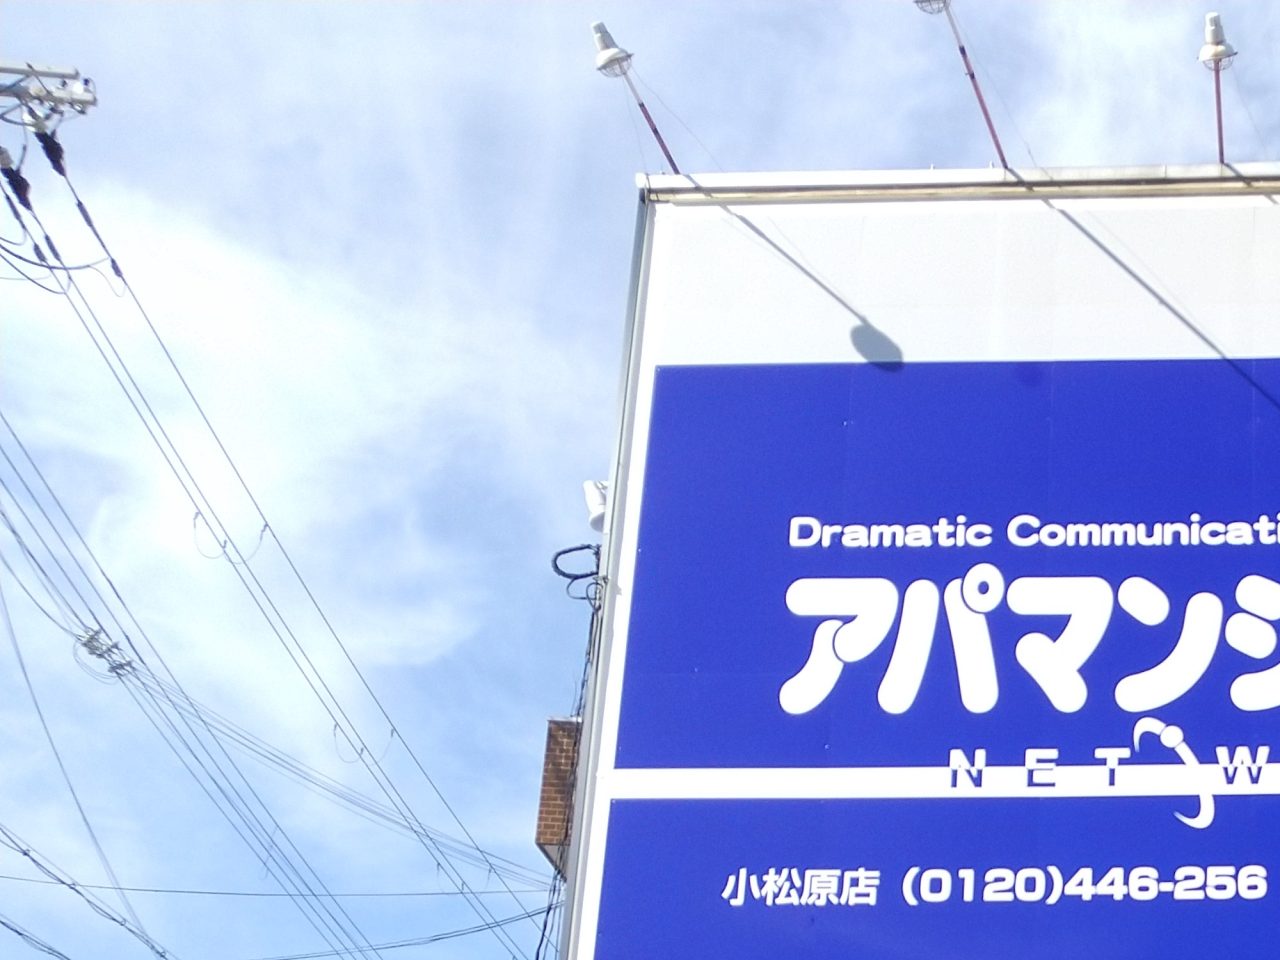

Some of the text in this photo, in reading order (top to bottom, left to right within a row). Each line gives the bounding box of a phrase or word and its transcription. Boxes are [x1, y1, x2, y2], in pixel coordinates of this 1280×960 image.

[788, 514, 993, 548] Dramatic
[721, 866, 881, 907] 小松原店
[902, 864, 1268, 906] (0120)446-256
